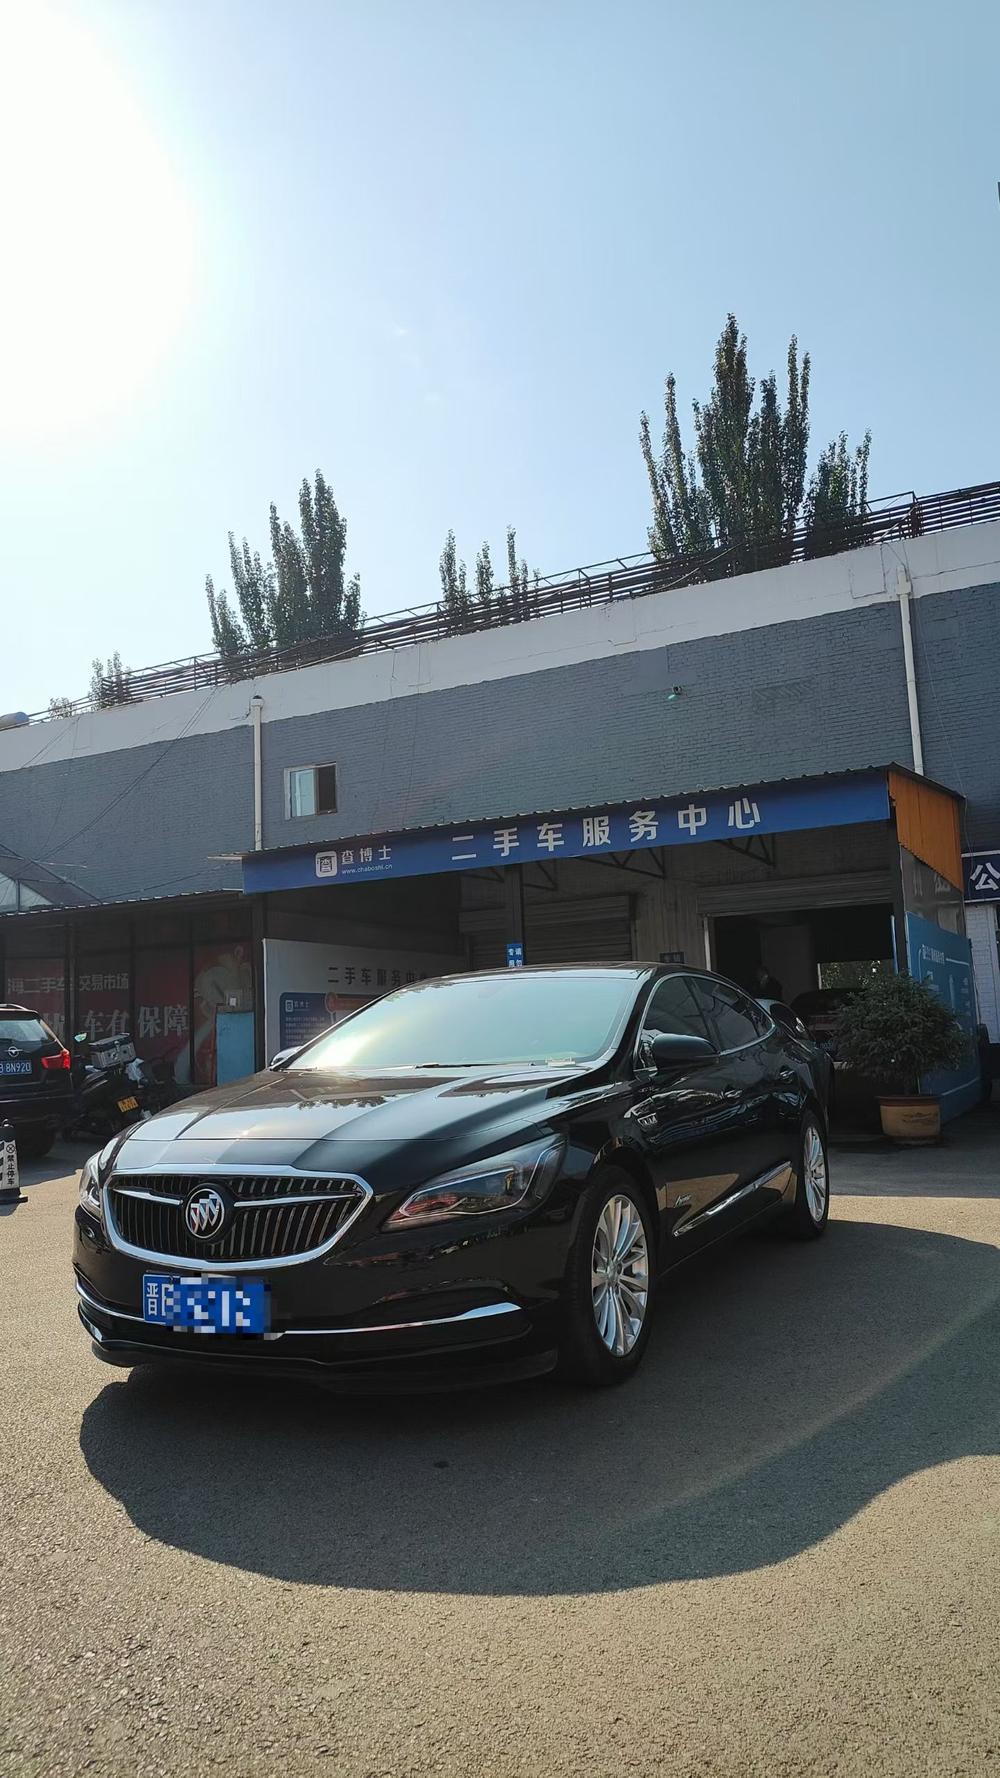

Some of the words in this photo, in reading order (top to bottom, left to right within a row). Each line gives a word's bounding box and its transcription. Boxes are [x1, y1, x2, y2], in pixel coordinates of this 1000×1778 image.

[451, 797, 761, 861] 二手车服务中心
[341, 845, 392, 865] 查博士
[342, 864, 393, 875] www.chaboshi.cn
[970, 862, 1000, 891] 公
